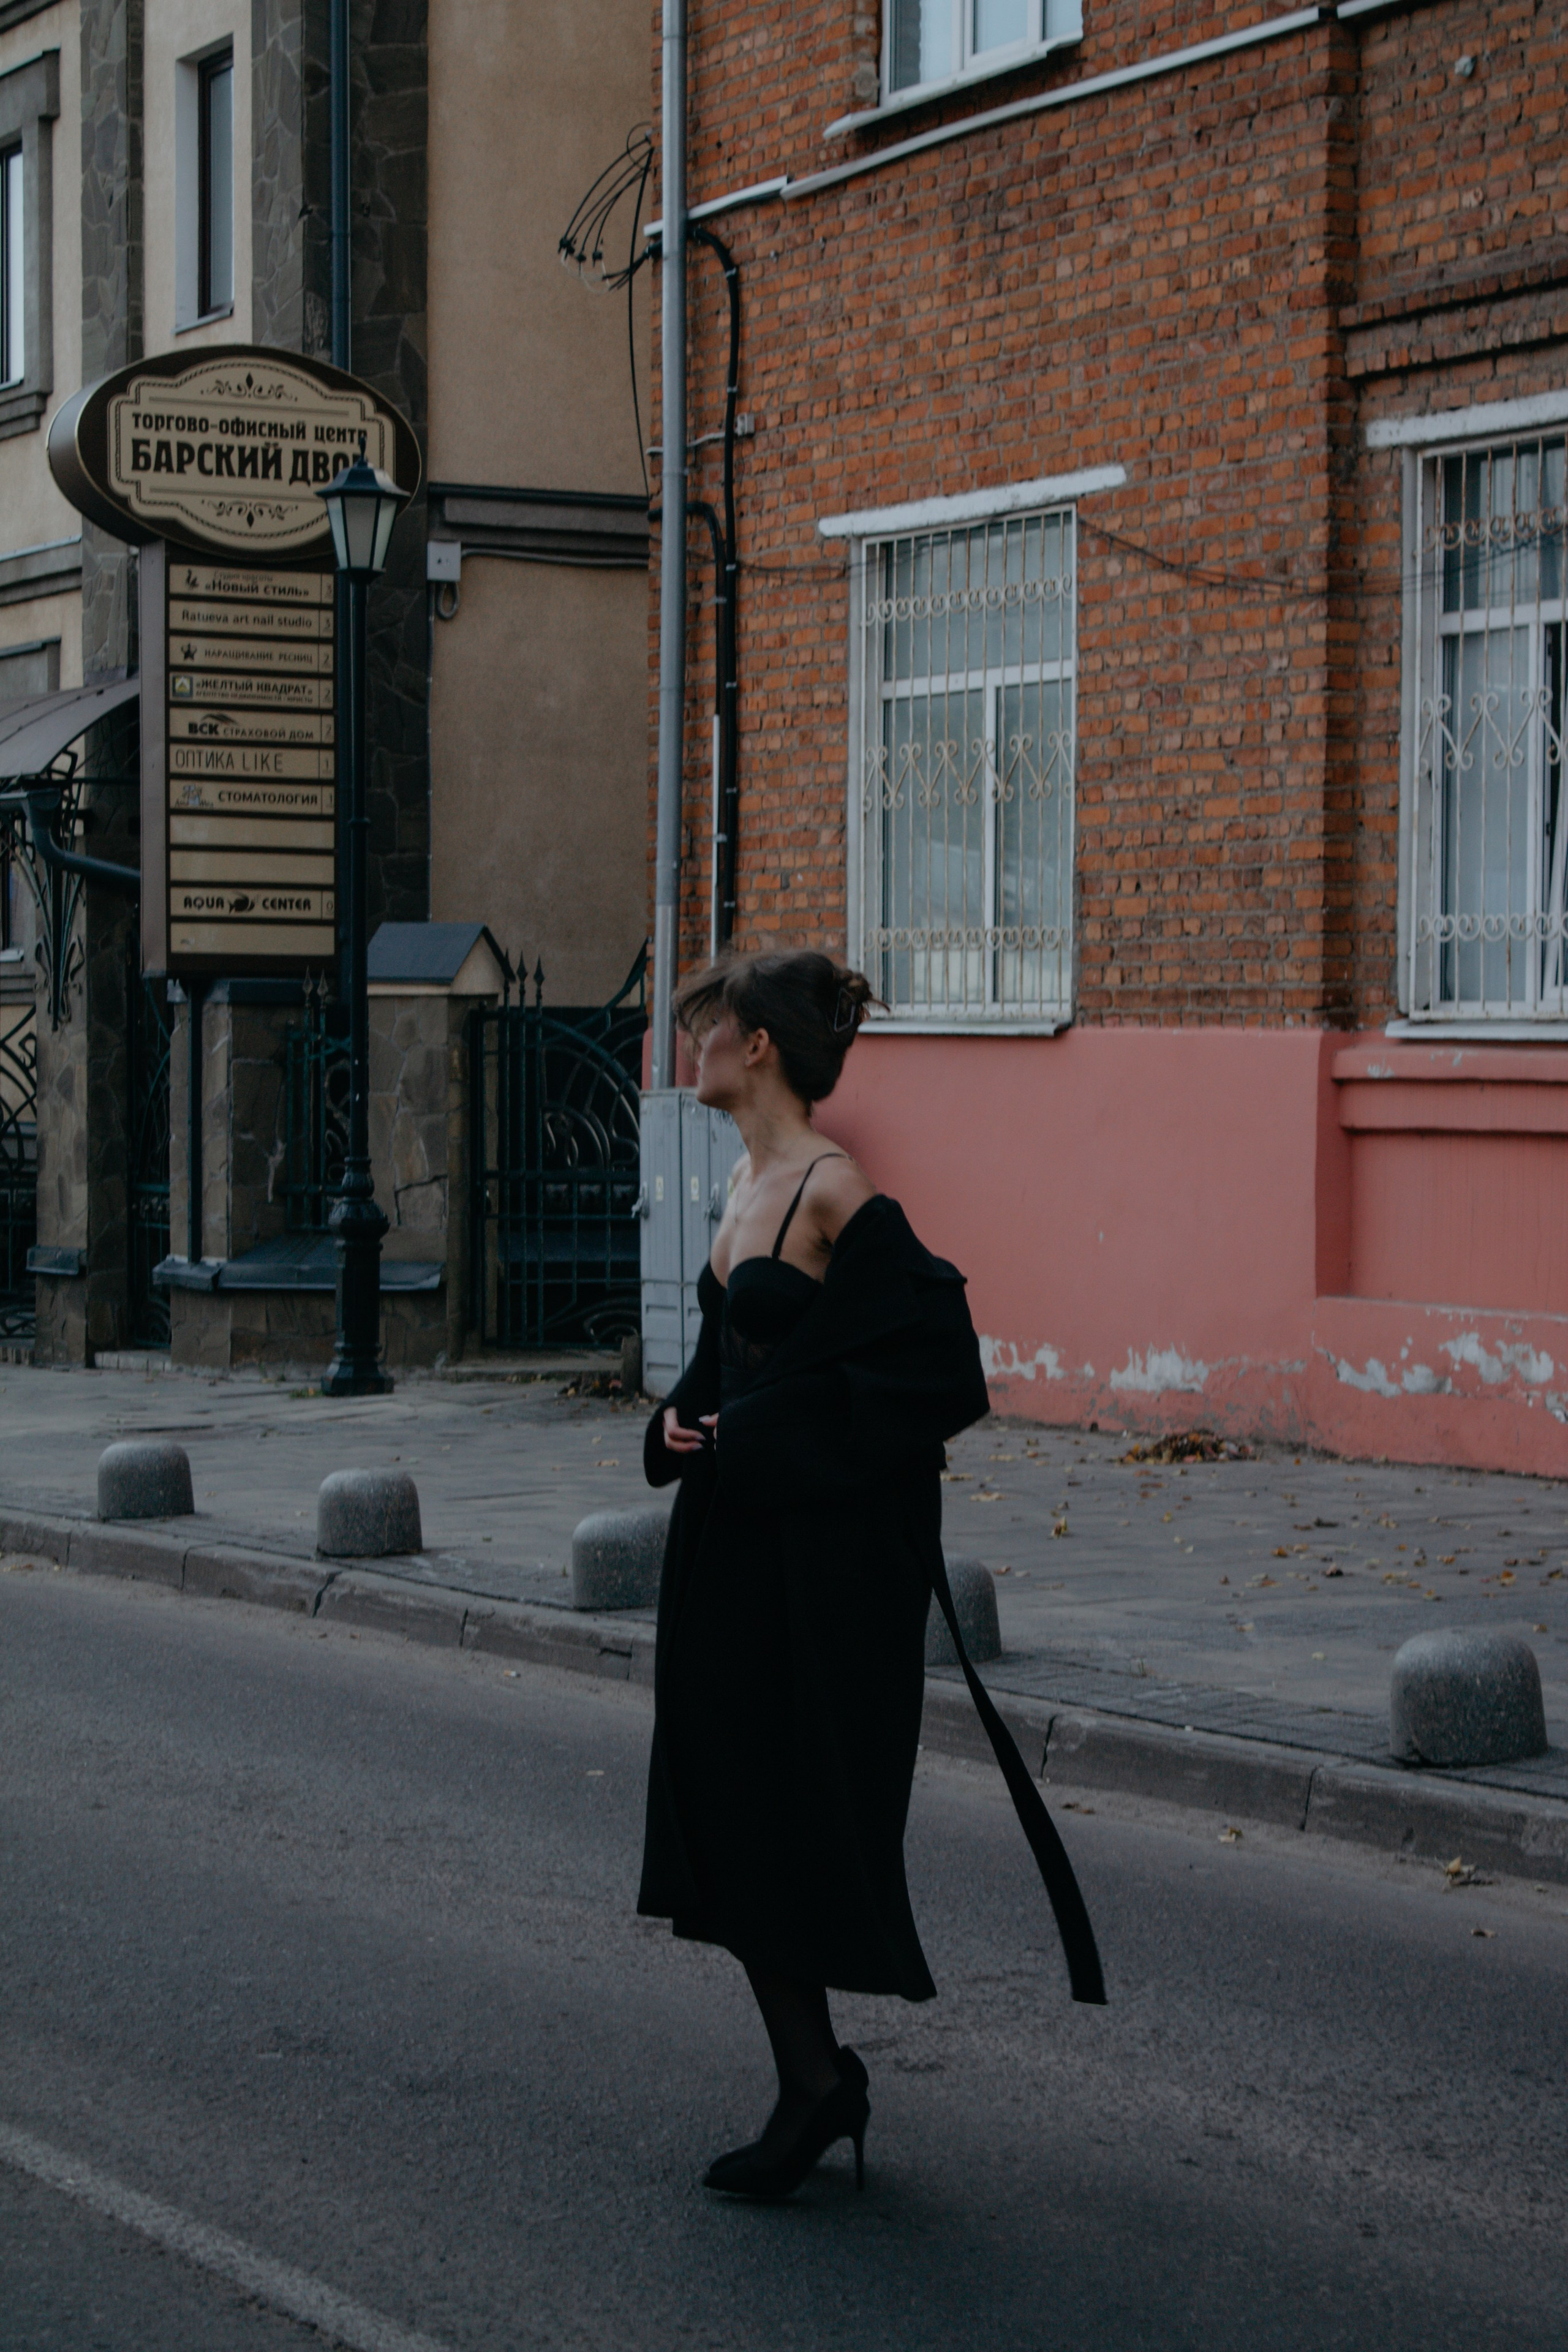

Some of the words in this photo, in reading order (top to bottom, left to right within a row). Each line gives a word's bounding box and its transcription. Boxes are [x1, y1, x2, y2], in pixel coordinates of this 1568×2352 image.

[132, 412, 306, 440] торгово-офисный
[131, 438, 282, 481] БАРСКИЙ
[289, 448, 368, 486] ДВО
[182, 609, 228, 624] Ratueva
[233, 614, 249, 625] art
[253, 614, 274, 625] nail
[277, 616, 312, 628] studio
[205, 649, 274, 661] НАРАЩИВАНИЕ
[279, 653, 312, 664] РЕСНИЦ
[188, 722, 219, 735] ВСК
[224, 727, 285, 739] СТРАХОВОЙ
[289, 729, 314, 741] ДОМ
[176, 748, 235, 770] ОПТИКА
[242, 751, 283, 773] LIKE
[218, 790, 318, 805] СТОМАТОЛОГИЯ
[184, 896, 224, 910] AQUA
[262, 897, 311, 911] CENTER
